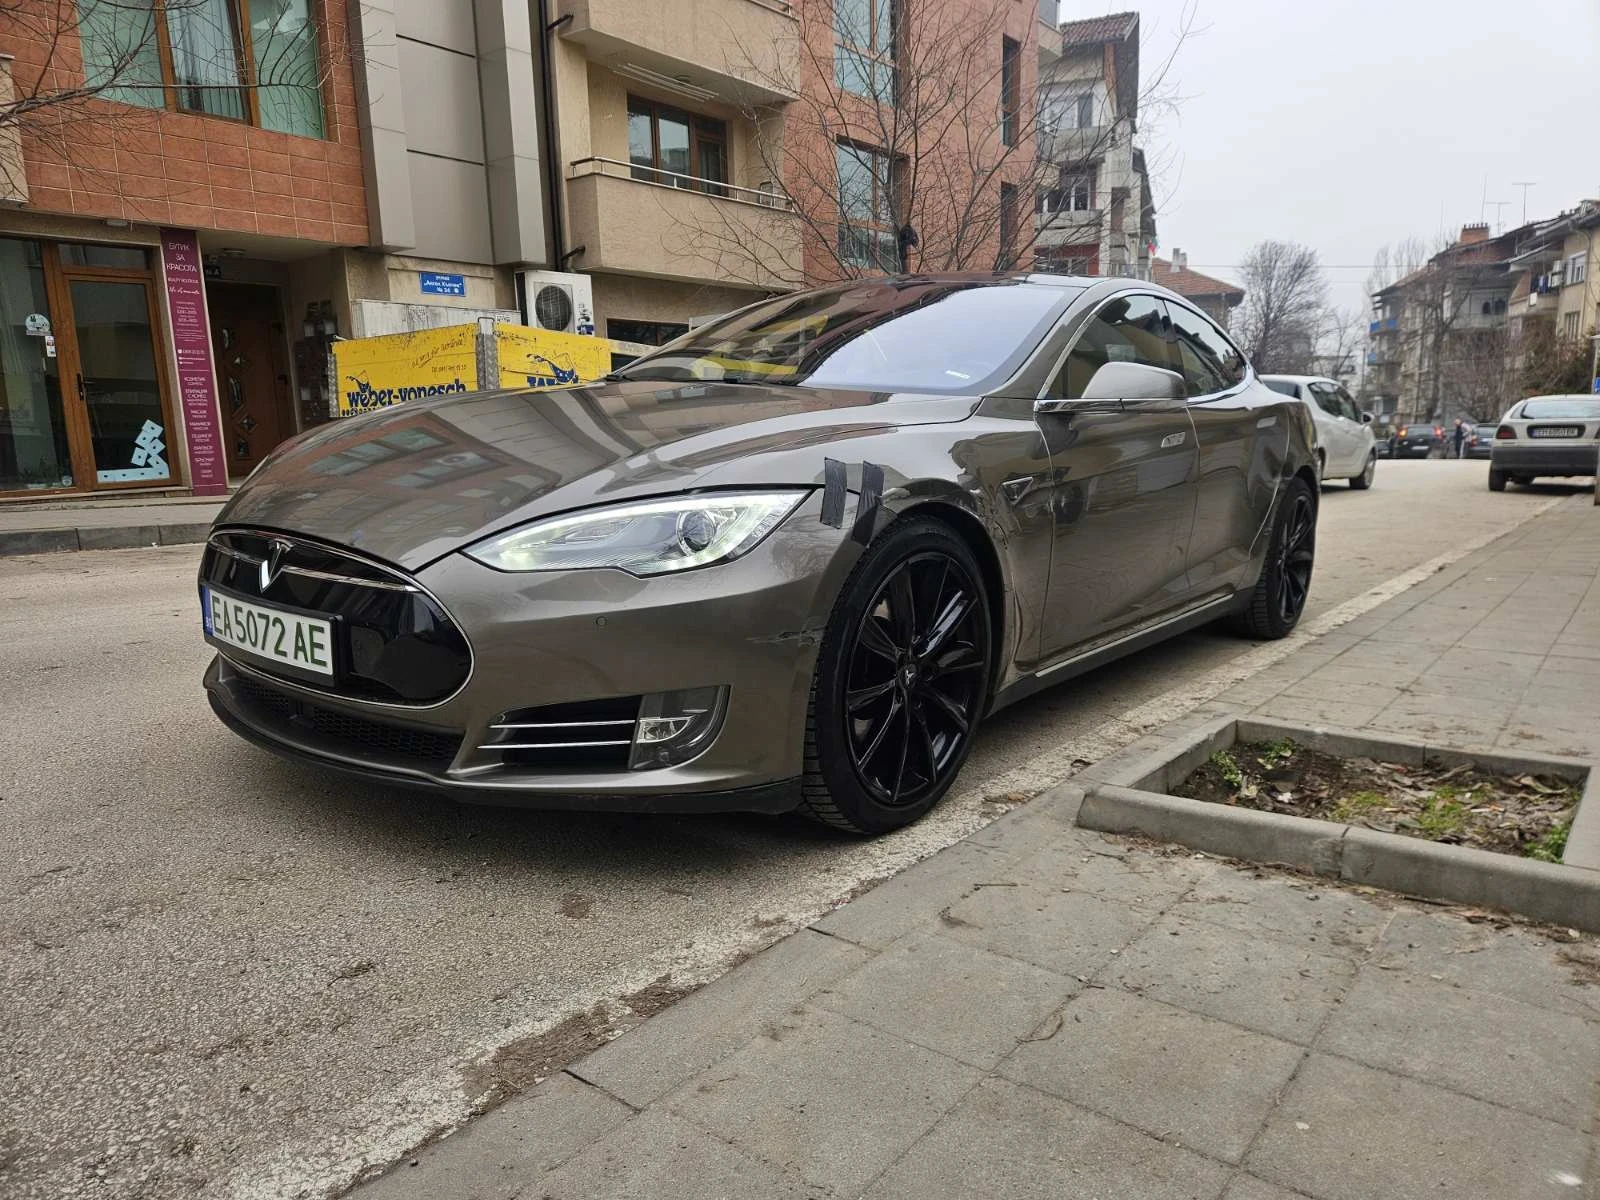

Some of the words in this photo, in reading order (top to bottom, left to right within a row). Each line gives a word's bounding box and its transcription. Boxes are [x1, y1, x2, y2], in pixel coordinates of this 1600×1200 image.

[168, 242, 190, 250] БУТИК
[175, 253, 186, 261] ЗА
[167, 263, 198, 272] КРАСОТА
[234, 605, 288, 657] 5072
[293, 621, 328, 668] AE
